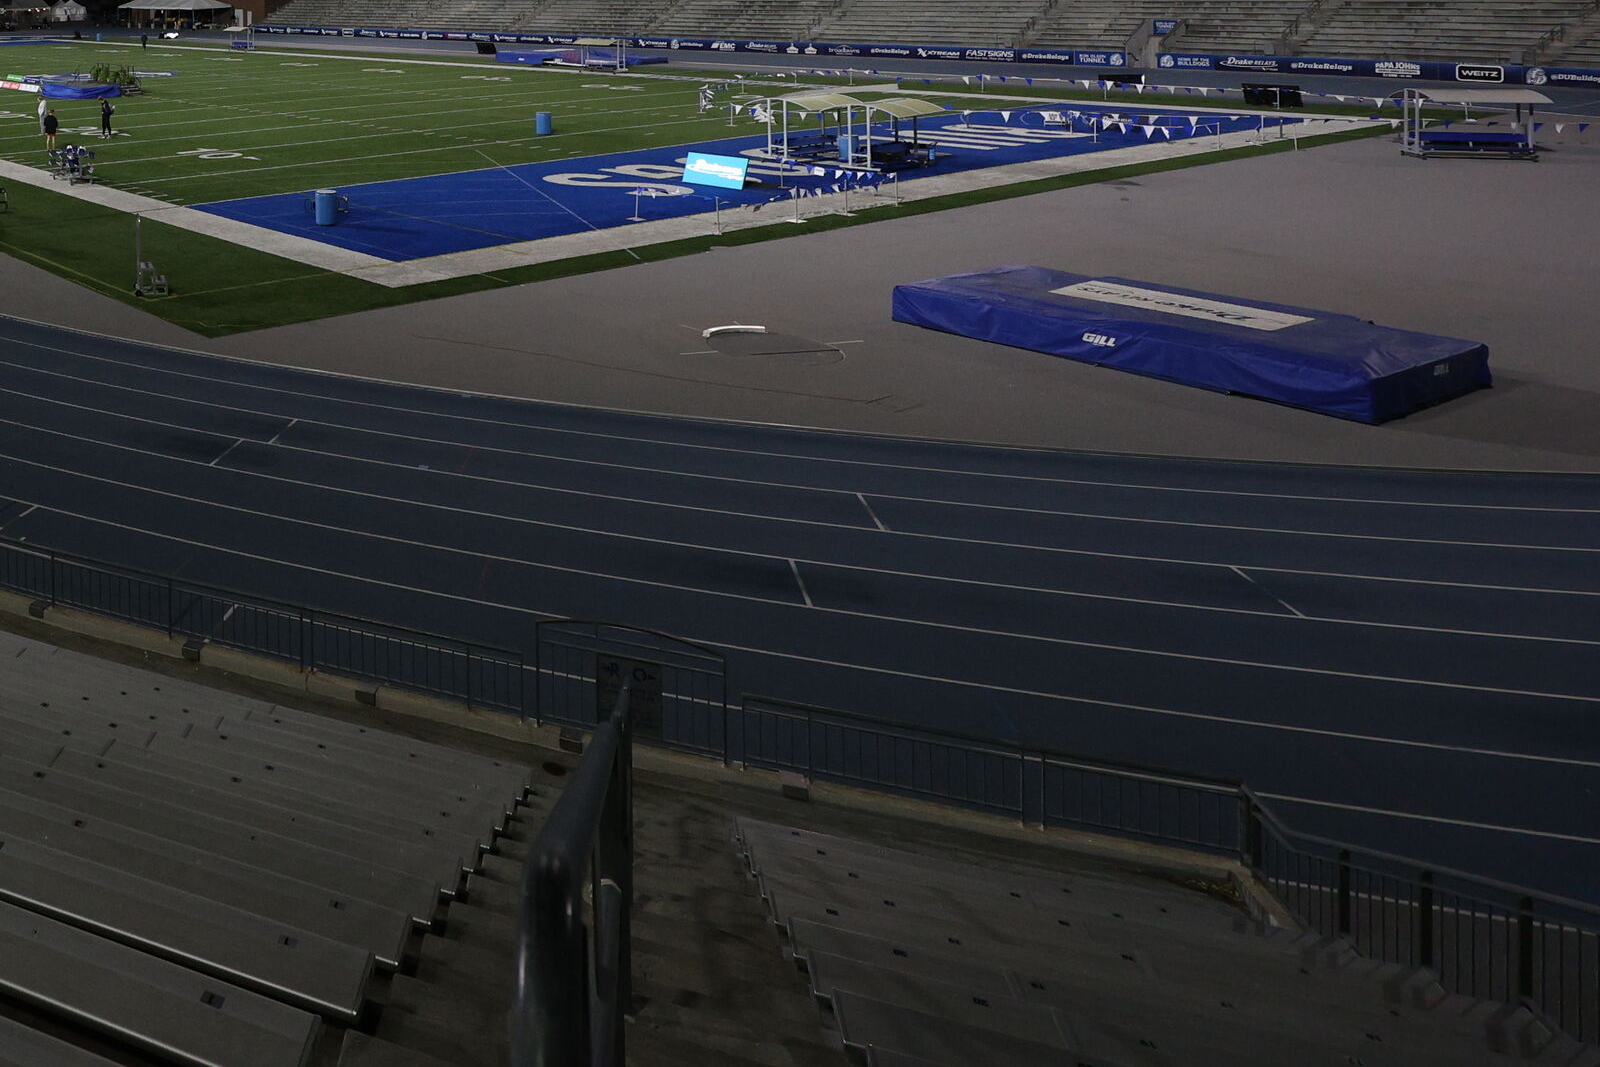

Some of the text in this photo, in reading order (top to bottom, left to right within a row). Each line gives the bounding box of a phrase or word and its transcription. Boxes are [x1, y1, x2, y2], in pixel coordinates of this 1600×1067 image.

[965, 49, 1015, 58] FASTSIGNS
[1021, 52, 1070, 61] @DrakeRelays
[1226, 56, 1254, 66] Drake
[1290, 61, 1353, 72] @DrakeRelays
[1374, 62, 1421, 71] PAPA JOHNS
[1460, 70, 1499, 78] WEITZ
[1081, 332, 1118, 349] GILL
